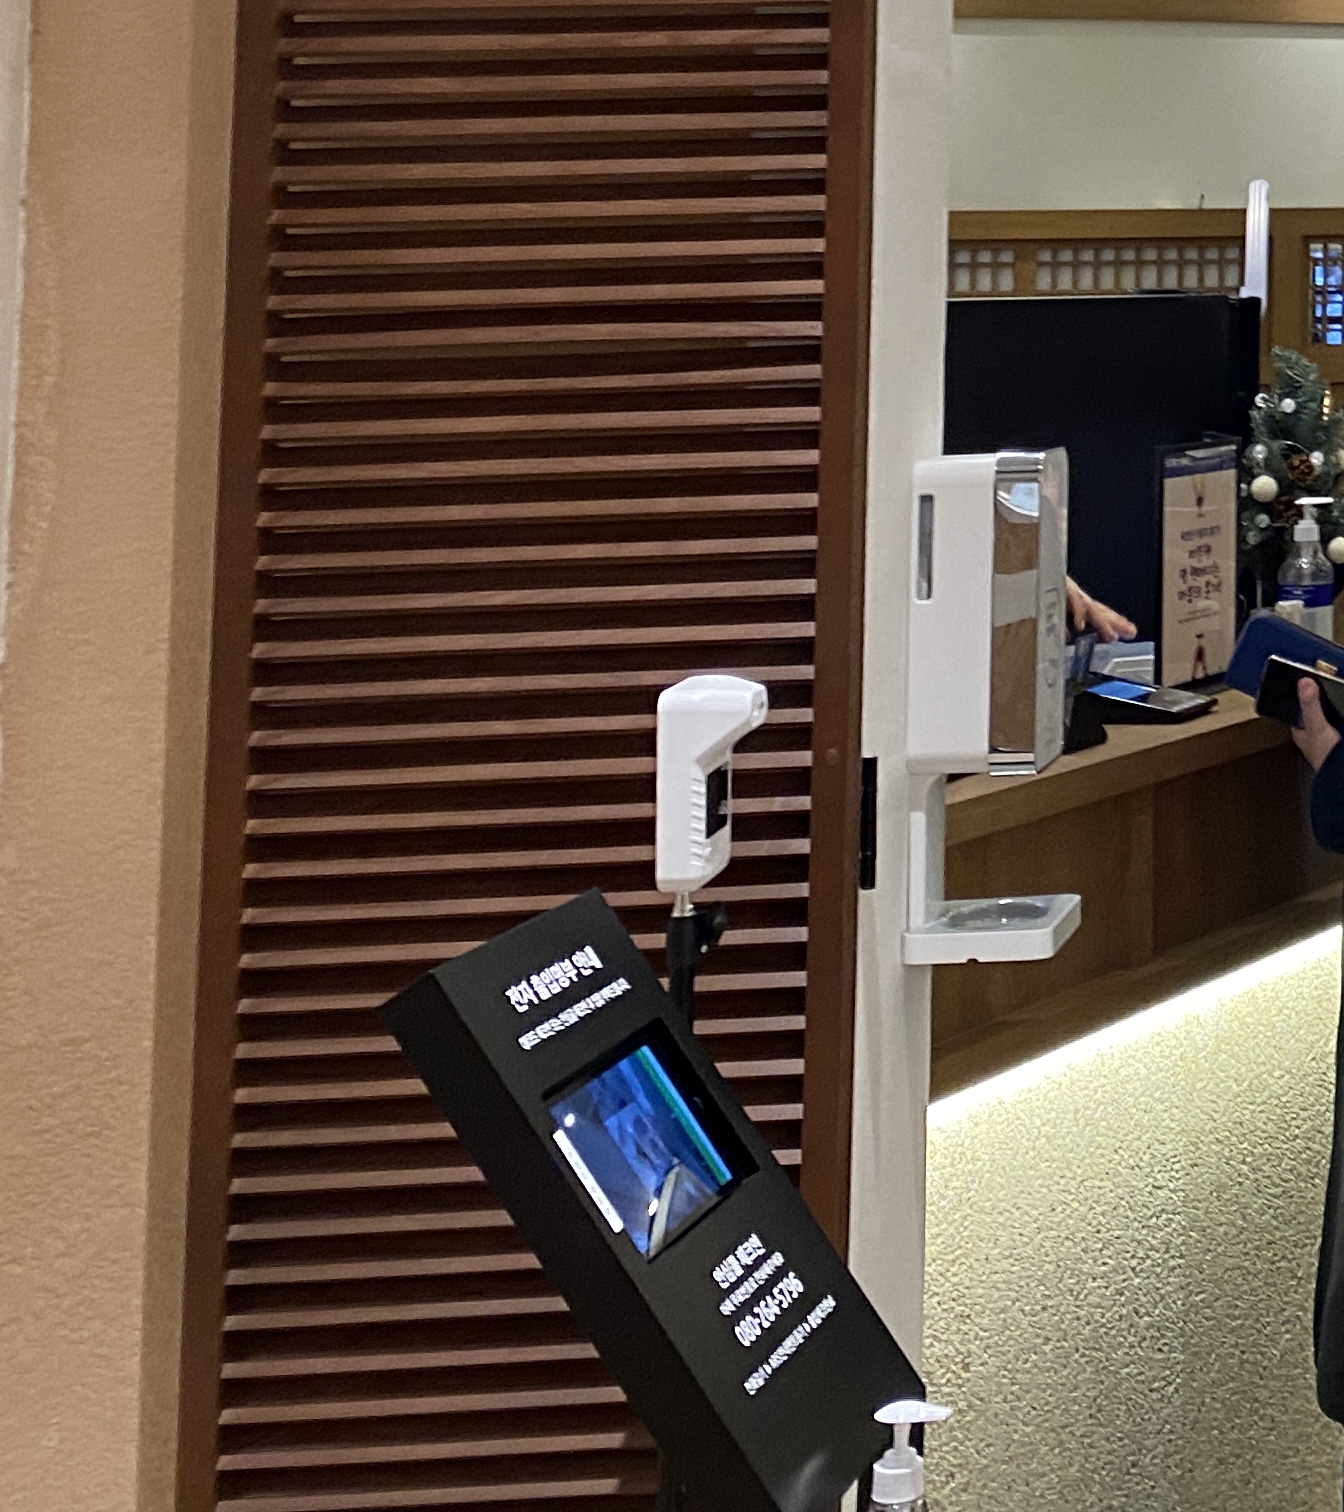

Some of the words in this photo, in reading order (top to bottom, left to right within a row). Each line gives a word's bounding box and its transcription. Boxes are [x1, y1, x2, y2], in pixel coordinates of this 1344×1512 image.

[504, 979, 540, 1013] 전자
[530, 958, 579, 1004] 출입명부
[572, 945, 604, 977] 안내
